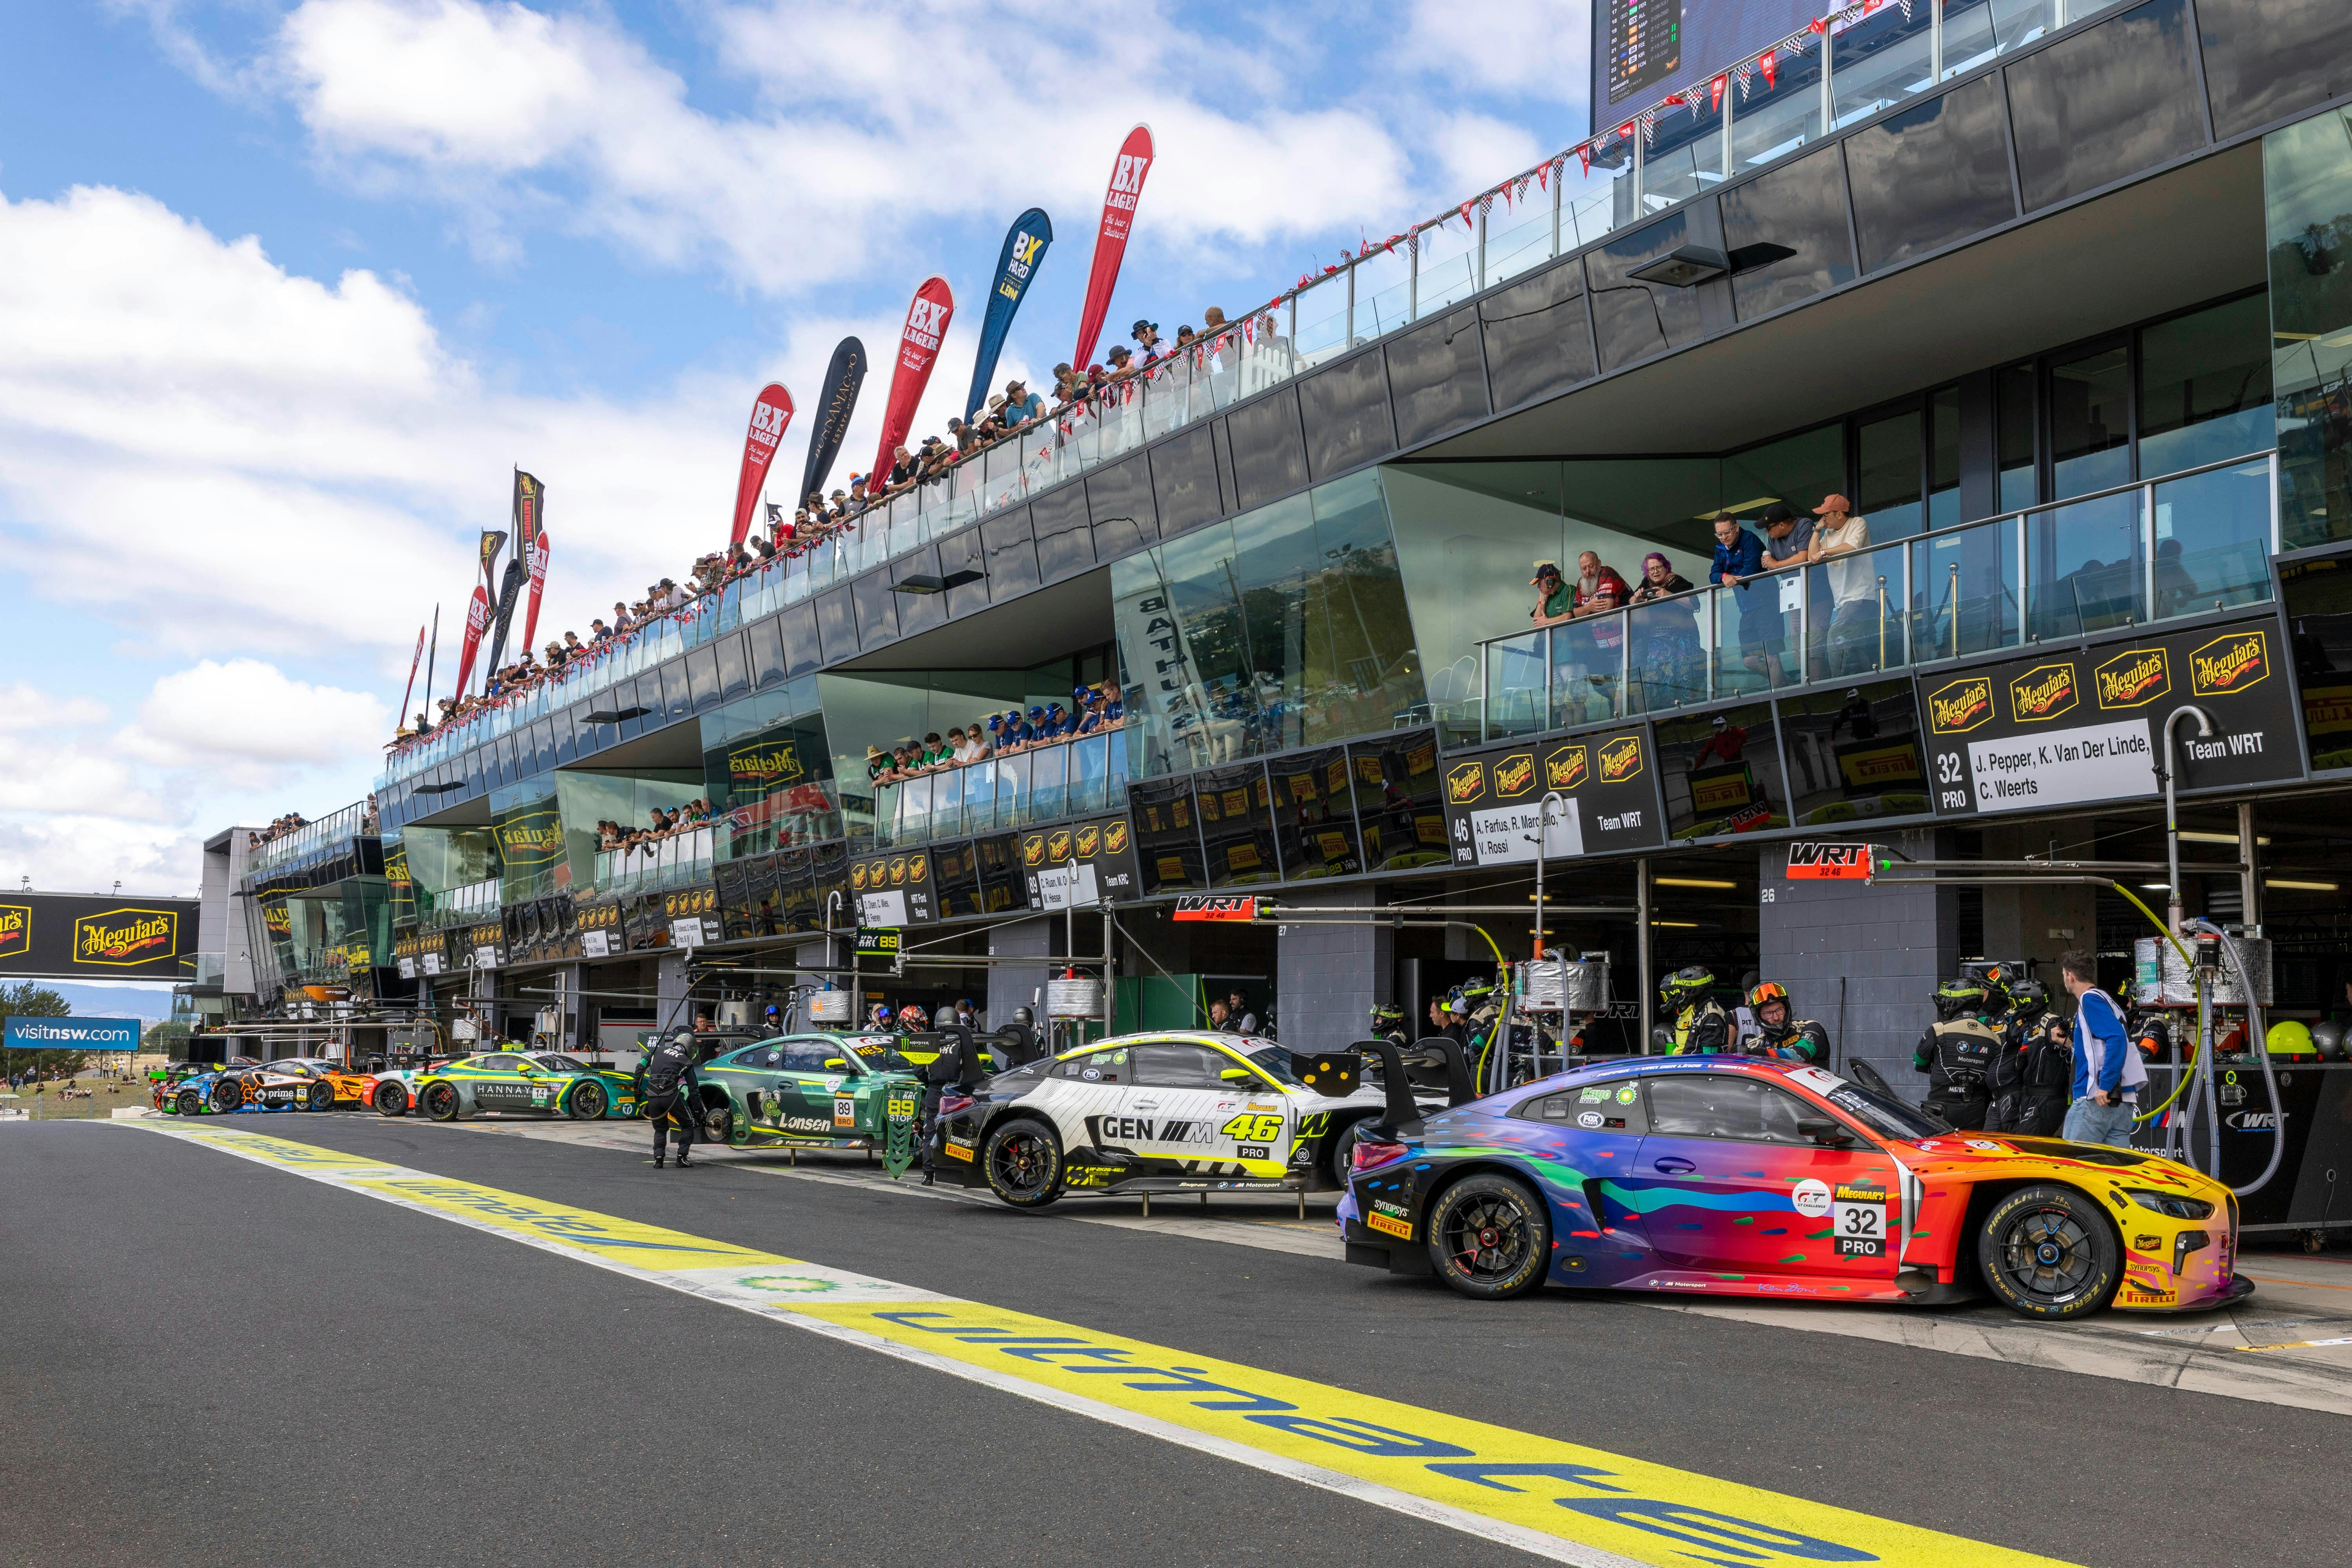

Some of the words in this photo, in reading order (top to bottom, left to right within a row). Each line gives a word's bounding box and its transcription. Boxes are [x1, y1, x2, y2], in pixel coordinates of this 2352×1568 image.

[1638, 60, 1646, 69] FON
[1111, 154, 1148, 194] BX
[1105, 214, 1114, 224] The
[1114, 217, 1125, 227] beer
[1104, 226, 1126, 240] Bathurst
[1013, 231, 1044, 266] BX
[1008, 258, 1029, 279] HARD
[908, 296, 948, 337] BX
[903, 327, 939, 351] LAGER
[903, 346, 912, 356] The
[911, 350, 922, 361] beer
[903, 356, 922, 372] Bathurst
[751, 401, 789, 436] BX
[832, 413, 849, 444] ESTATE
[846, 381, 856, 411] WINES
[749, 427, 778, 448] LAGER
[524, 500, 532, 540] BATHURST
[525, 542, 533, 552] 12
[526, 553, 534, 575] HOU
[534, 546, 548, 571] BX
[470, 596, 487, 623] BX
[468, 614, 484, 631] LAGER
[1934, 682, 1987, 727] Meguiar's
[2016, 668, 2070, 715] Meguiar's
[2101, 653, 2162, 702] Meguiar's
[2196, 637, 2260, 688] Meguiar's
[1976, 755, 1987, 773] J.
[1989, 748, 2036, 772] Pepper,
[2038, 746, 2051, 764] K.
[2053, 742, 2079, 762] Van
[2082, 738, 2105, 757] Der
[2107, 731, 2151, 757] Linde,
[2185, 739, 2225, 761] Team
[2227, 732, 2264, 756] WRT
[1450, 766, 1481, 799] Meguiar's
[1497, 759, 1531, 793] Meguiar's
[1549, 750, 1584, 784] Meguiar's
[1602, 740, 1639, 777] Meguiar's
[1937, 752, 1962, 784] 32
[1980, 783, 1993, 800] C.
[1996, 776, 2038, 798] Weerts
[1943, 789, 1966, 809] PRO
[1476, 822, 1483, 835] A.
[1485, 817, 1510, 834] Farfus,
[1511, 817, 1520, 830] R.
[1521, 812, 1559, 829] Marcello,
[1597, 815, 1622, 831] Team
[1621, 811, 1641, 828] WRT
[1106, 824, 1125, 850] Meguiar's
[1455, 818, 1468, 842] 46
[1457, 847, 1472, 861] PRO
[1478, 843, 1486, 856] V.
[1488, 840, 1509, 855] Rossi
[1788, 843, 1866, 866] WRT
[1820, 868, 1830, 876] 32
[1831, 867, 1841, 876] 46
[1029, 876, 1038, 894] 89
[1046, 877, 1058, 889] Ruan,
[1105, 876, 1118, 887] Team
[1118, 873, 1129, 885] KRC
[918, 893, 927, 903] Ford
[1032, 897, 1041, 908] BRO
[1049, 894, 1062, 903] Hesse
[1761, 888, 1775, 903] 26
[856, 898, 863, 914] 64
[1176, 896, 1252, 912] WRT
[915, 907, 928, 919] Racing
[82, 915, 170, 956] Meguiar's
[668, 924, 674, 936] 14
[1278, 926, 1287, 936] 27
[128, 942, 140, 952] Since
[879, 936, 897, 948] 89
[989, 946, 994, 955] 28
[15, 1024, 129, 1041] visitnsw.com
[856, 1045, 884, 1056] HES
[1091, 1054, 1112, 1064] Kayo
[1958, 1056, 1985, 1065] Motorsport
[1597, 1069, 1630, 1077] PEPPER
[268, 1089, 294, 1099] prime
[477, 1085, 531, 1094] HANNAY
[535, 1089, 544, 1098] 14
[1581, 1087, 1612, 1103] Kayo
[838, 1102, 850, 1115] 89
[888, 1099, 914, 1116] 89
[1247, 1102, 1278, 1112] MEGUIAR'S
[779, 1113, 831, 1132] Lonsen
[1220, 1113, 1284, 1142] 46
[2242, 1113, 2290, 1127] WRT
[1103, 1116, 1154, 1141] GEN
[947, 1145, 971, 1159] PIRELLI
[1242, 1148, 1264, 1158] PRO
[1837, 1186, 1884, 1200] MEGUIAR'S
[386, 1180, 609, 1232] ultimate
[1430, 1190, 1457, 1246] PIRELLI
[1845, 1208, 1878, 1236] 32
[1987, 1195, 2026, 1235] PIRELLI
[1371, 1215, 1409, 1236] PIRELLI
[1843, 1240, 1877, 1254] PRO
[2137, 1238, 2160, 1249] Meguiar's
[1514, 1247, 1540, 1287] ZERO
[1758, 1283, 1784, 1292] Ken
[1784, 1282, 1818, 1294] Done
[2063, 1285, 2100, 1313] ZERO
[2127, 1290, 2175, 1303] PIRELLI
[873, 1310, 1883, 1568] ultimate
